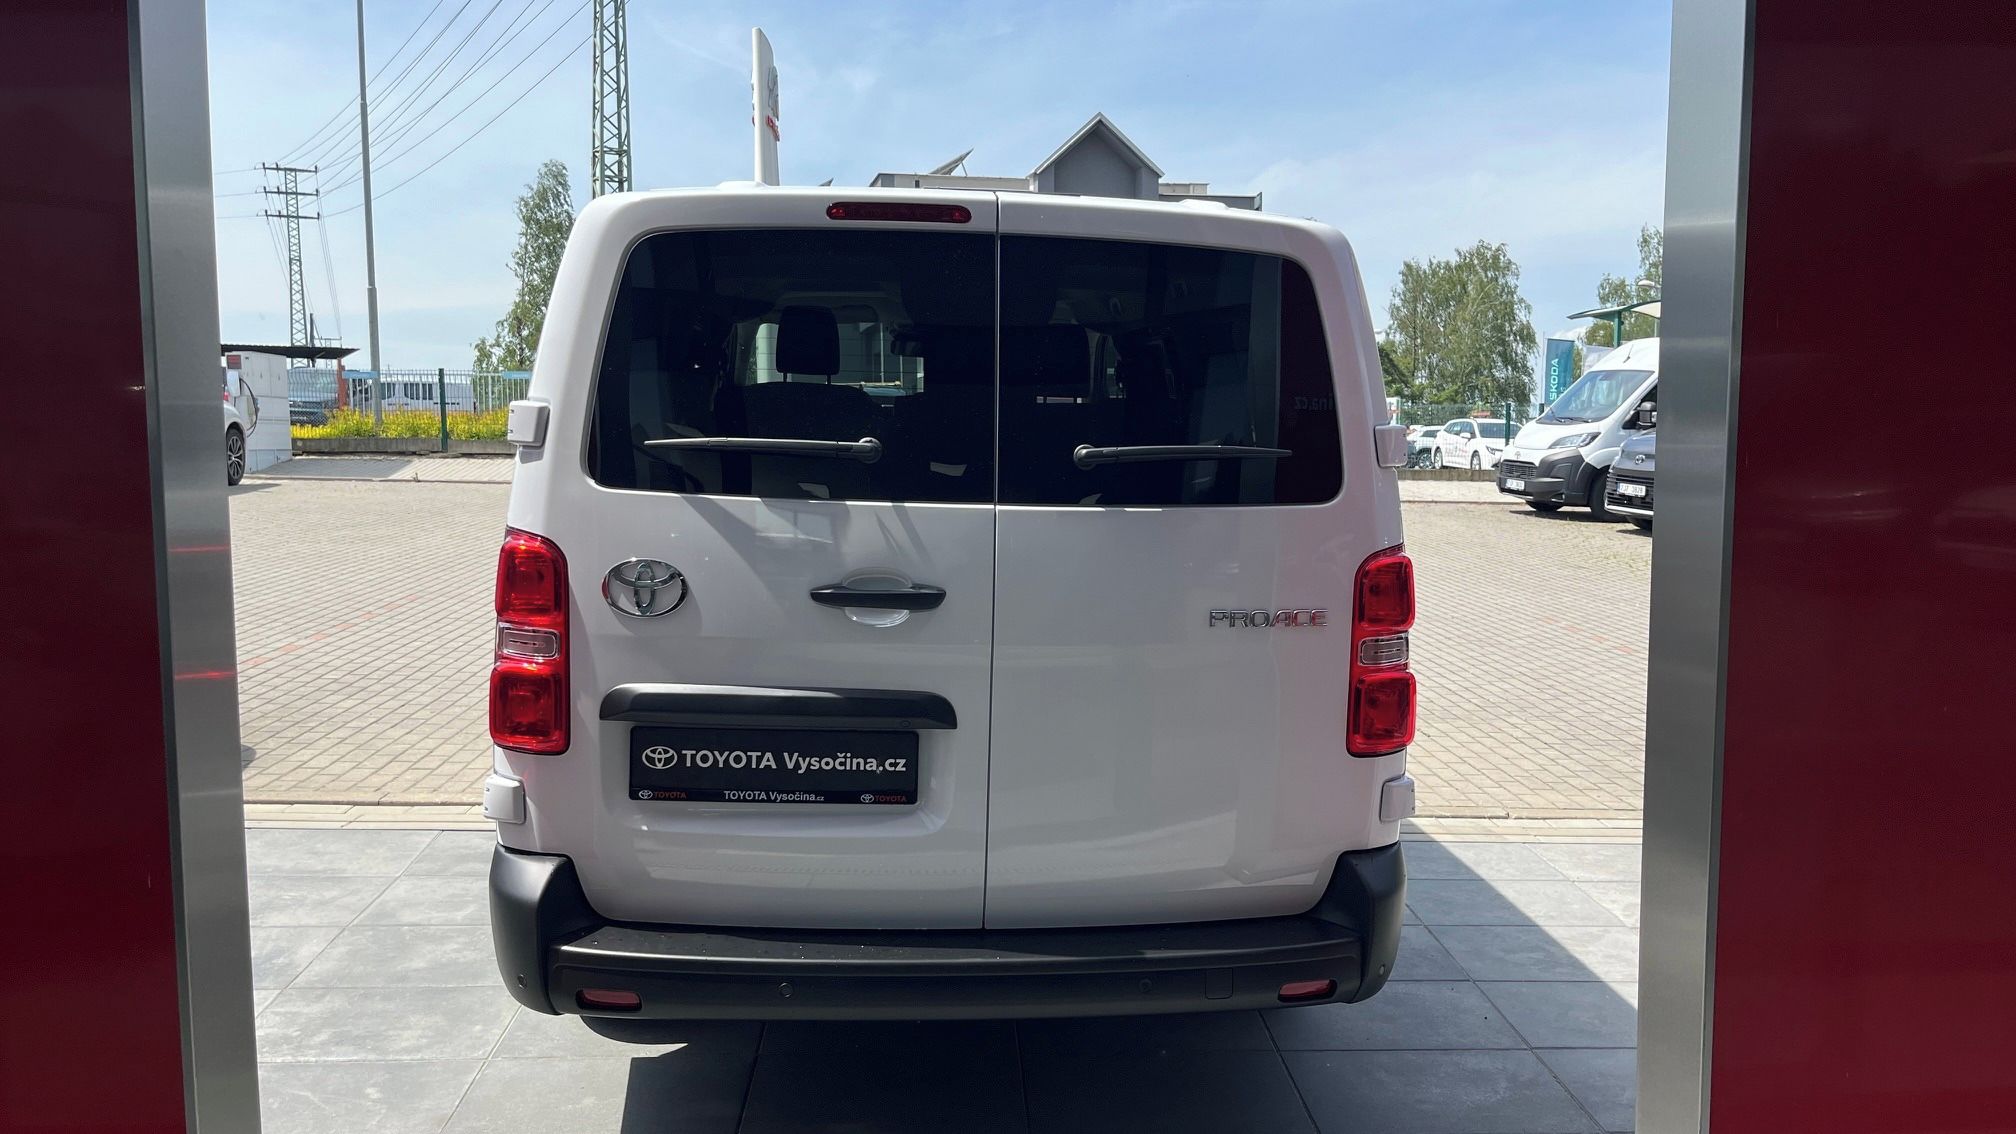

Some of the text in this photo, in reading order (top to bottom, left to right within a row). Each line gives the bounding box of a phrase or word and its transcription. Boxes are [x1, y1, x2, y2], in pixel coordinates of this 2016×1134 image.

[1209, 608, 1328, 628] PROACE
[681, 749, 907, 774] TOYOTA Vysočina.cz
[654, 791, 688, 800] TOYOTA
[723, 790, 767, 801] TOYOTA
[874, 794, 907, 803] TOYOTA
